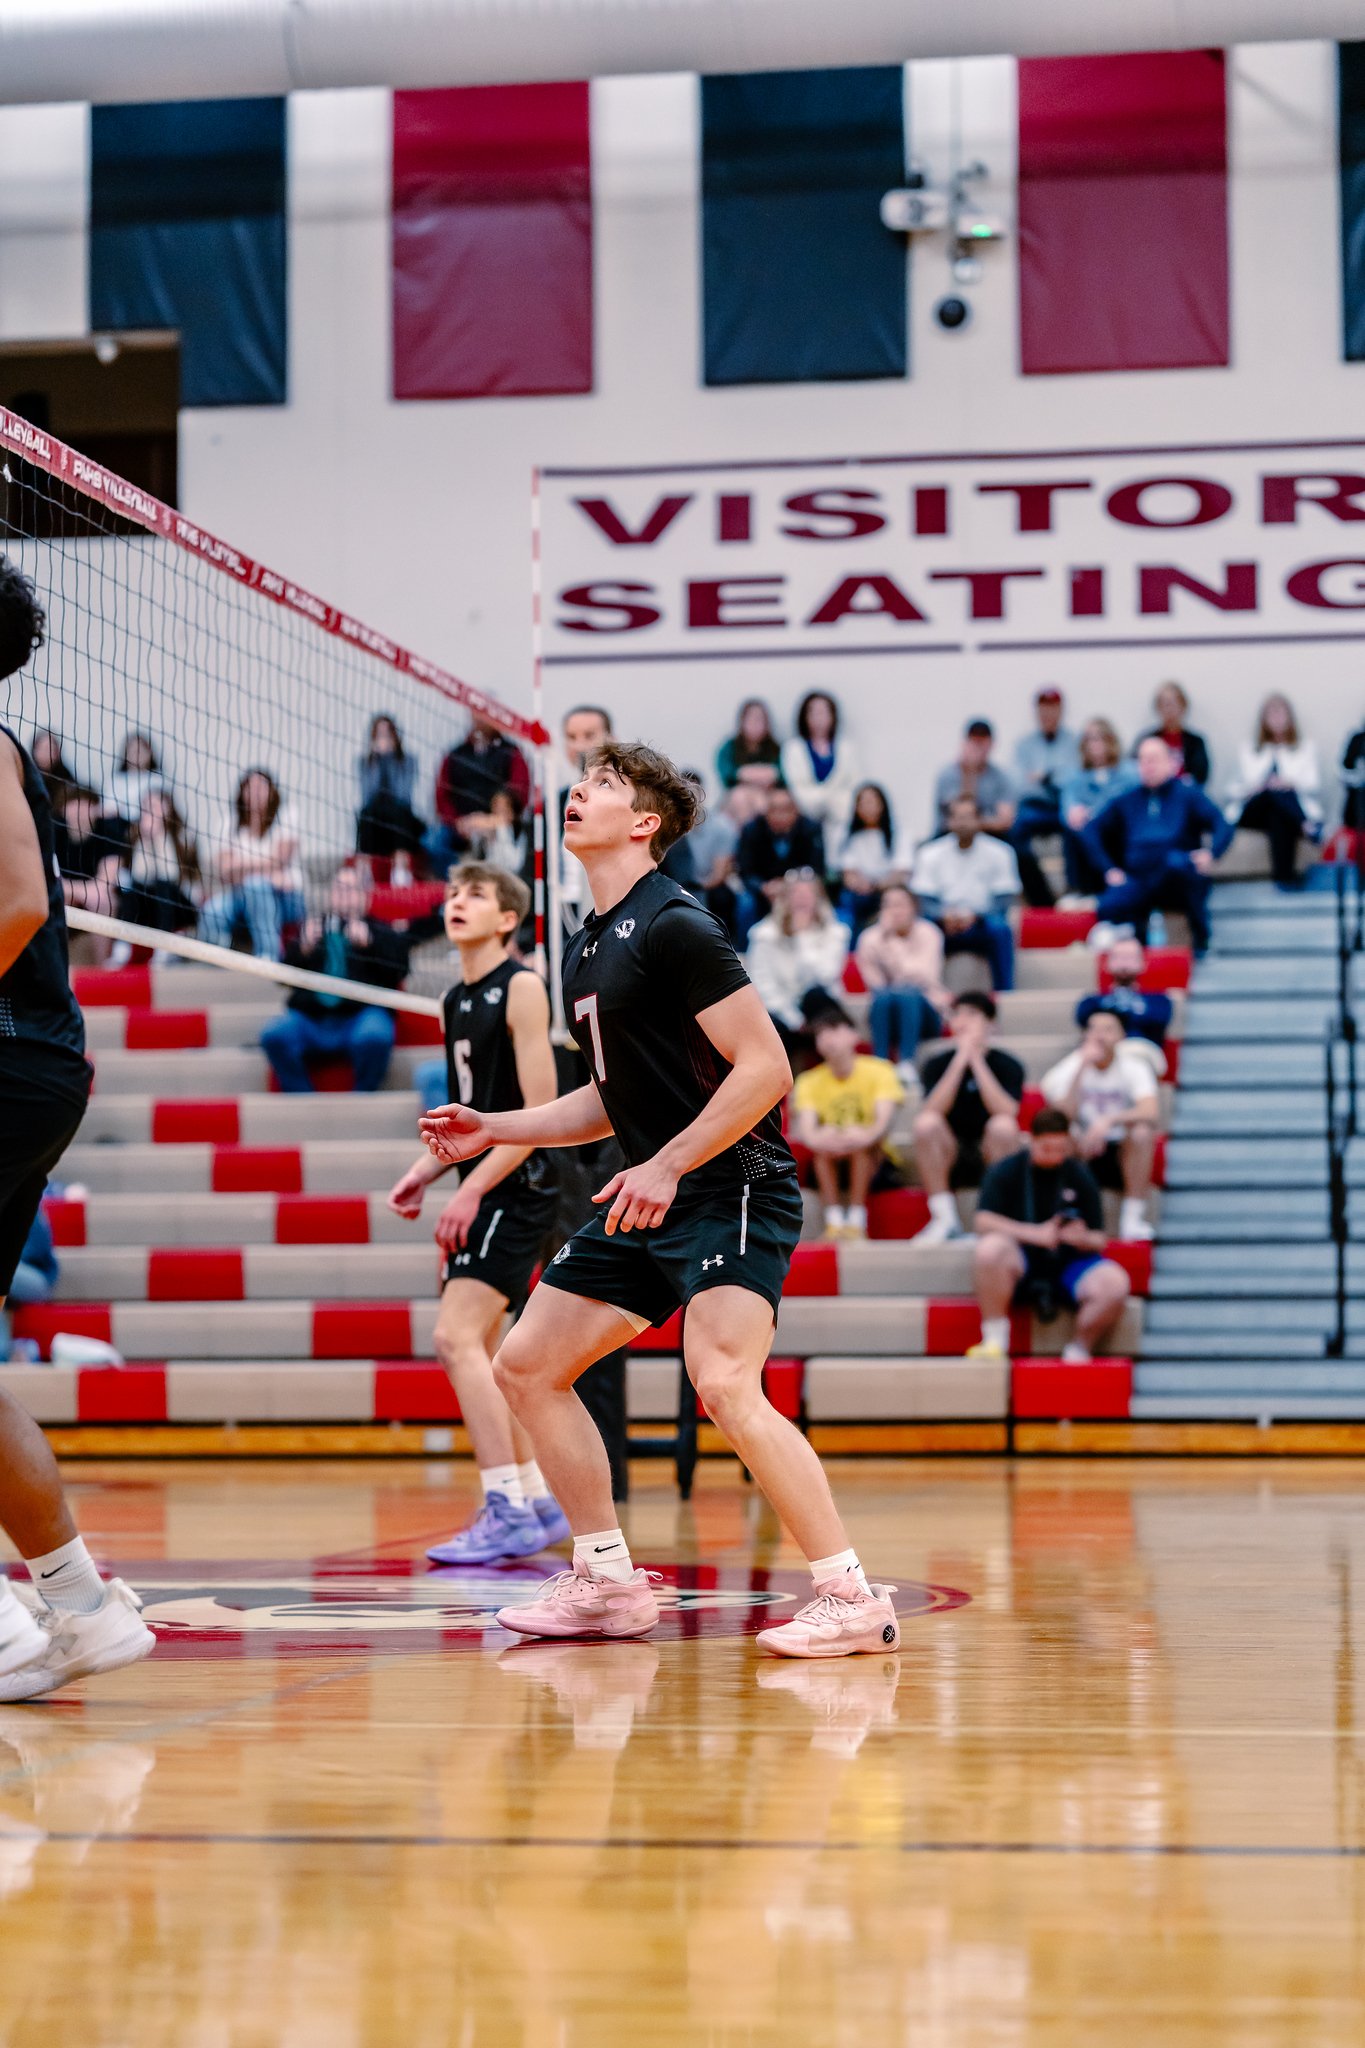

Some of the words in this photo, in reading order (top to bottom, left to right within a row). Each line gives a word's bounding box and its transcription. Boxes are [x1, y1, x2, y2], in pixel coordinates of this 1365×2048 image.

[571, 474, 1365, 546] VISITOR
[557, 559, 1365, 633] SEATING
[453, 1038, 473, 1105] 6
[574, 992, 607, 1085] 7
